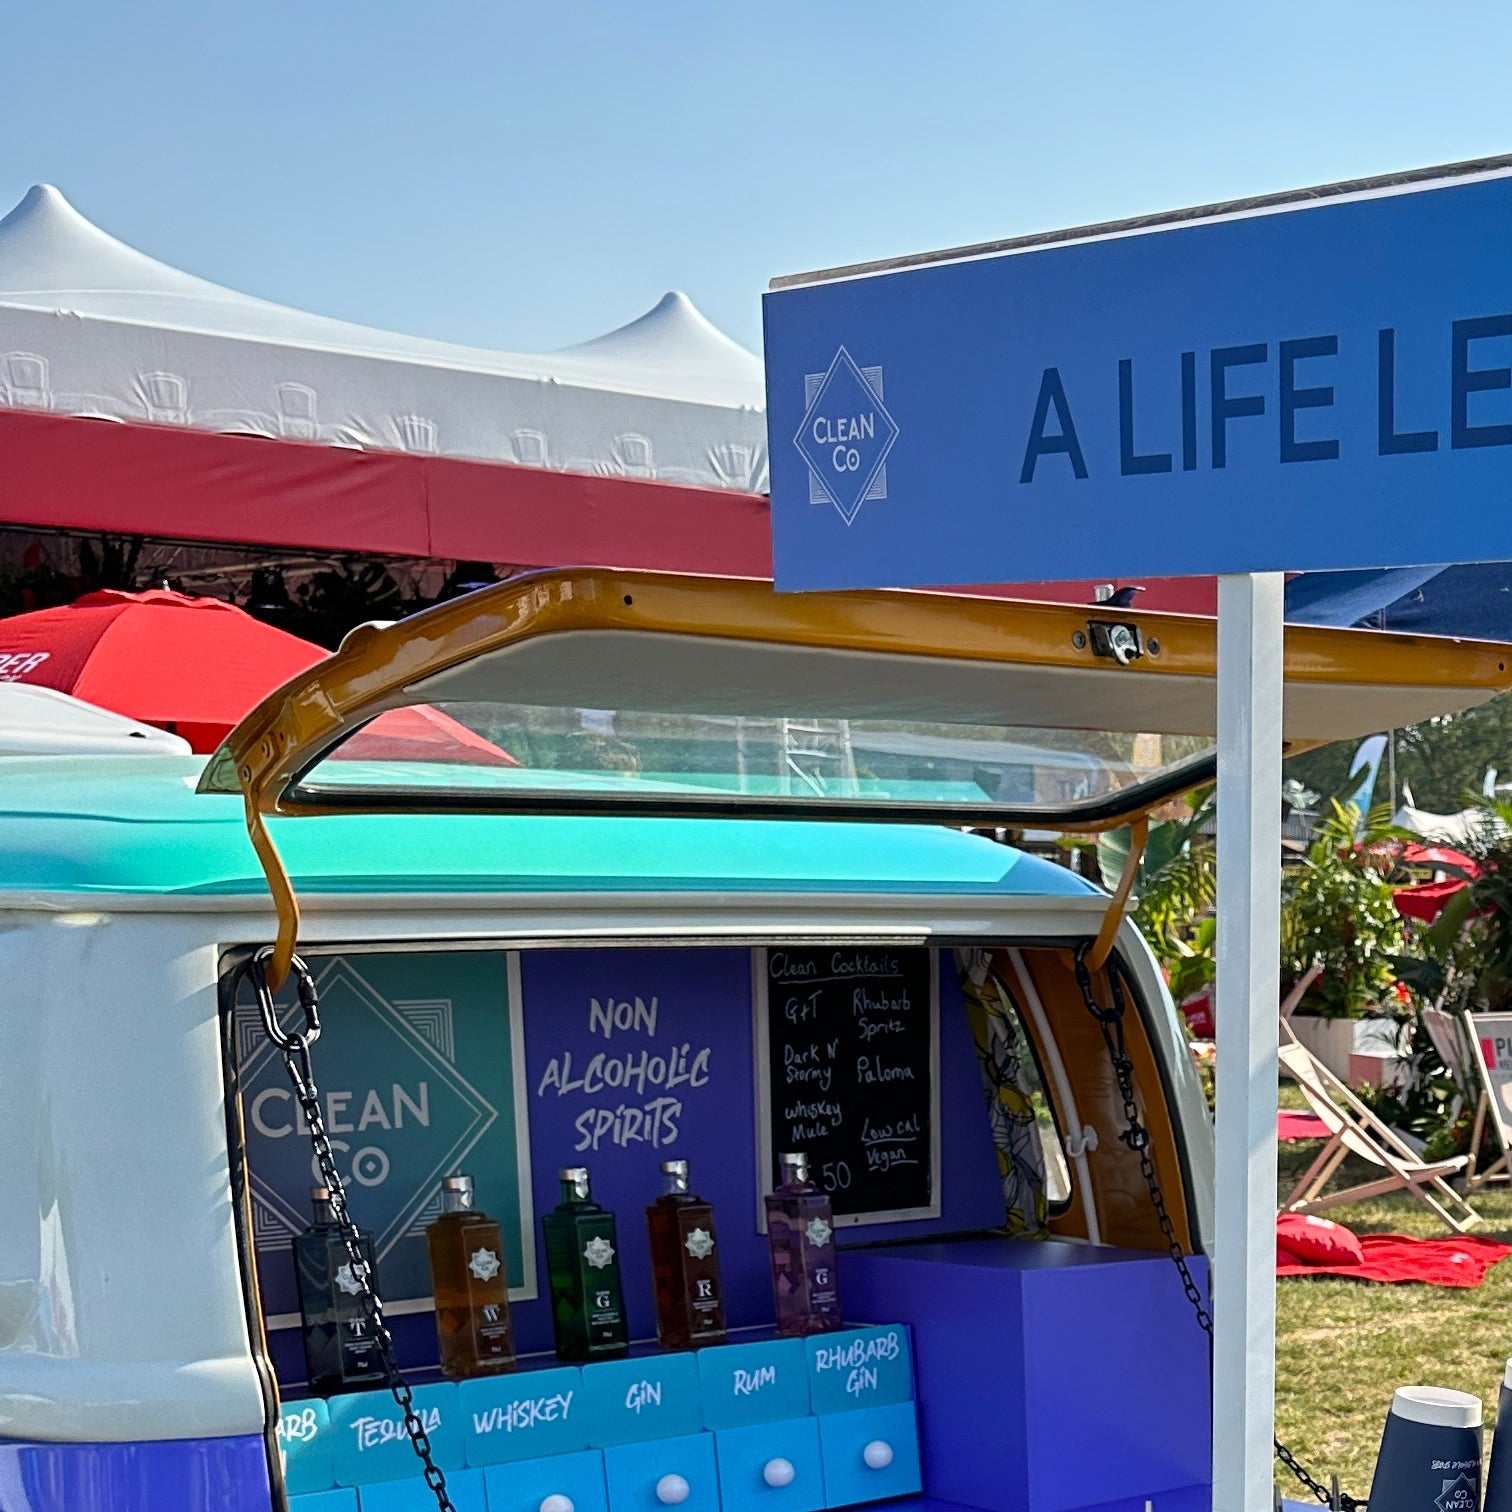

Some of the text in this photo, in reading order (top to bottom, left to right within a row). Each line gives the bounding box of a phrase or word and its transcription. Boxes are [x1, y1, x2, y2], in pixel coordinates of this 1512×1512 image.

[1019, 368, 1089, 484] A
[1118, 334, 1340, 477] LIFE
[813, 414, 875, 444] CLEAN
[770, 952, 900, 978] Clean Cocktails
[853, 988, 911, 1016] Rhubarb
[590, 996, 658, 1039] NON
[859, 1017, 905, 1041] Spritz
[786, 1065, 832, 1091] Stormy
[857, 1056, 915, 1083] Paloma
[791, 1125, 829, 1143] Mule
[860, 1117, 893, 1142] Low
[866, 1148, 907, 1172] Vegan
[815, 1331, 899, 1372] RHUBARB
[734, 1365, 775, 1396] RUM
